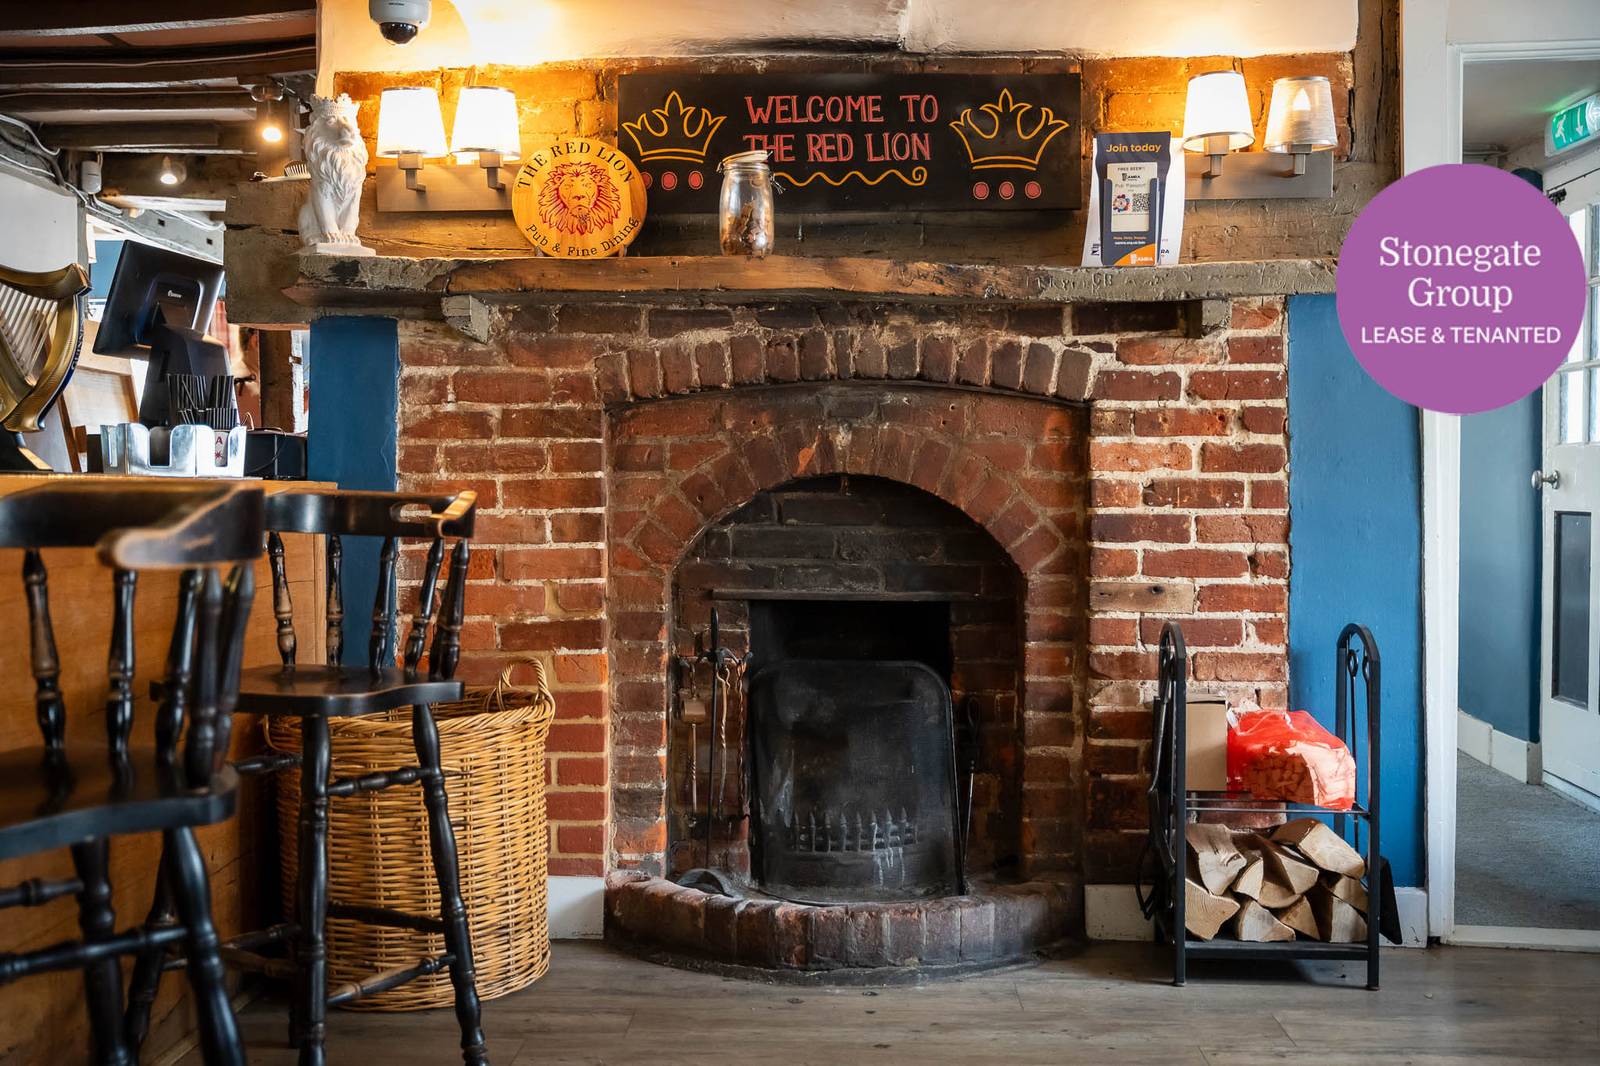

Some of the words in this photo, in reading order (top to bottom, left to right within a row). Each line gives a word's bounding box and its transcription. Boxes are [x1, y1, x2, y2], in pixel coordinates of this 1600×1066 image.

[744, 95, 885, 124] WELCOME
[900, 94, 939, 123] TO
[743, 133, 796, 162] THE
[806, 133, 854, 162] RED
[865, 132, 932, 162] LION
[1106, 144, 1129, 153] Join
[1130, 143, 1162, 153] today
[518, 154, 548, 188] THE
[550, 142, 591, 157] RED
[596, 147, 635, 184] LION
[526, 224, 549, 246] Pub
[552, 243, 561, 253] &
[567, 246, 598, 256] Fine
[600, 216, 640, 251] Dining
